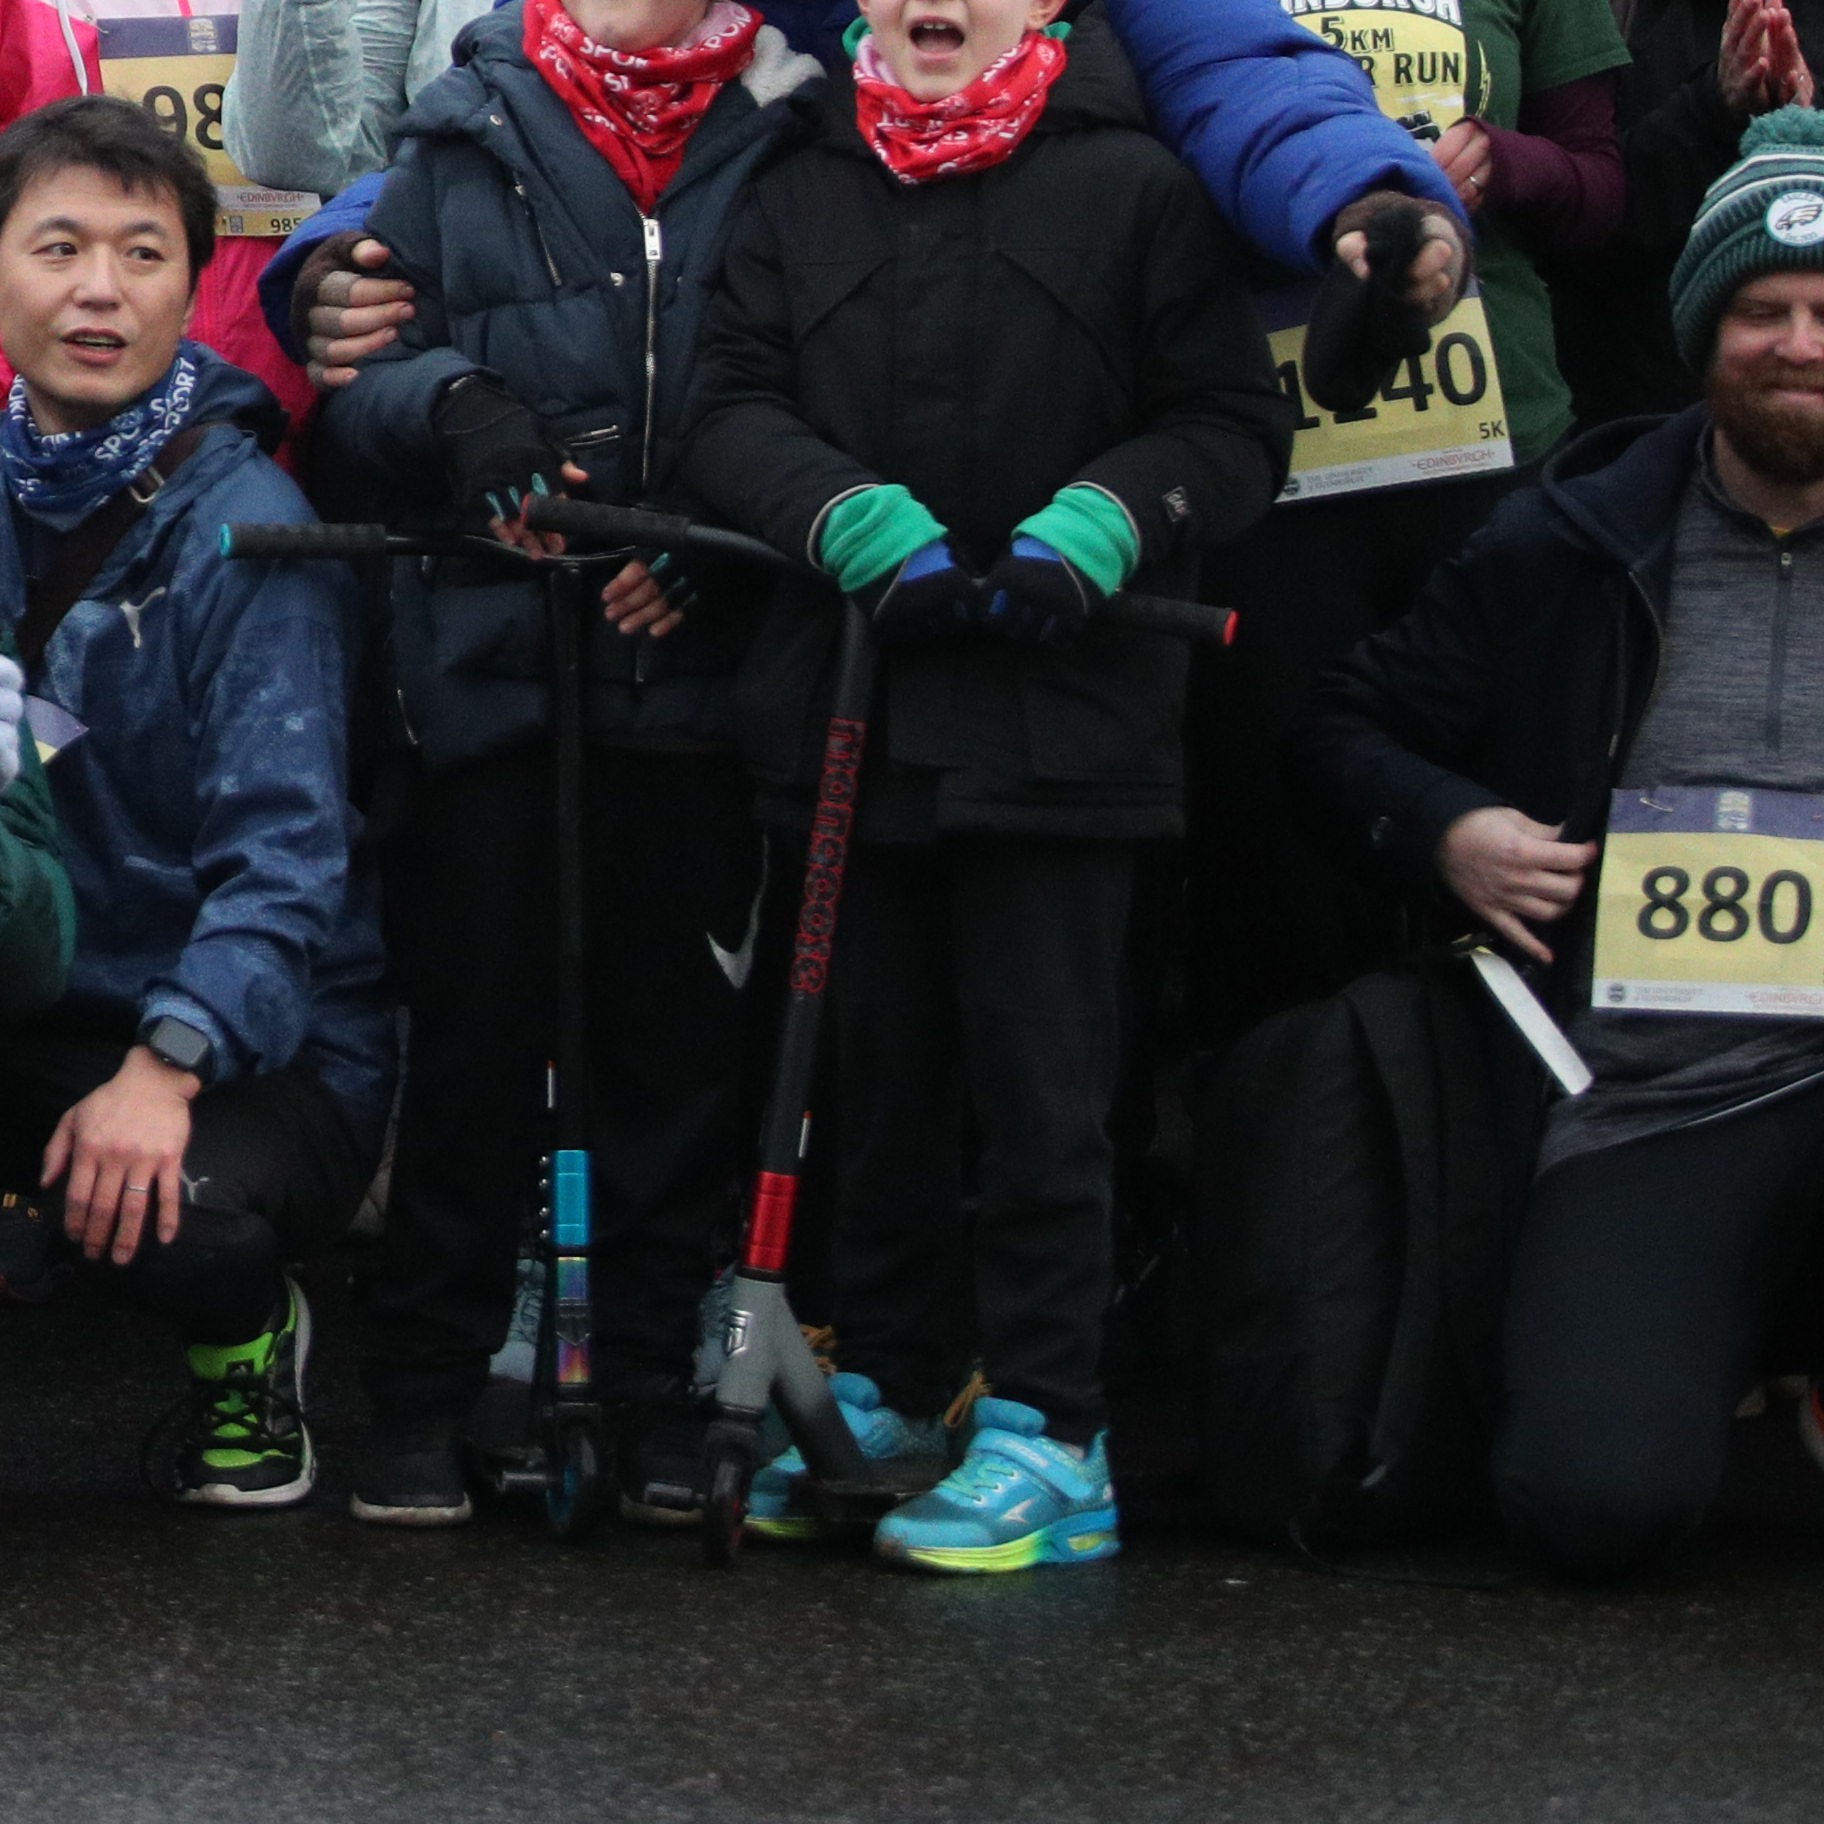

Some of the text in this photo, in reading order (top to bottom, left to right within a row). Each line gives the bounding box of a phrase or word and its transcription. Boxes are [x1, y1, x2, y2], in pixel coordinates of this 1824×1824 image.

[1320, 15, 1395, 54] 5KM
[1394, 51, 1462, 87] RUN
[142, 82, 227, 151] 98
[1274, 331, 1488, 432] 140
[1479, 420, 1506, 440] 5K
[1636, 865, 1812, 945] 880
